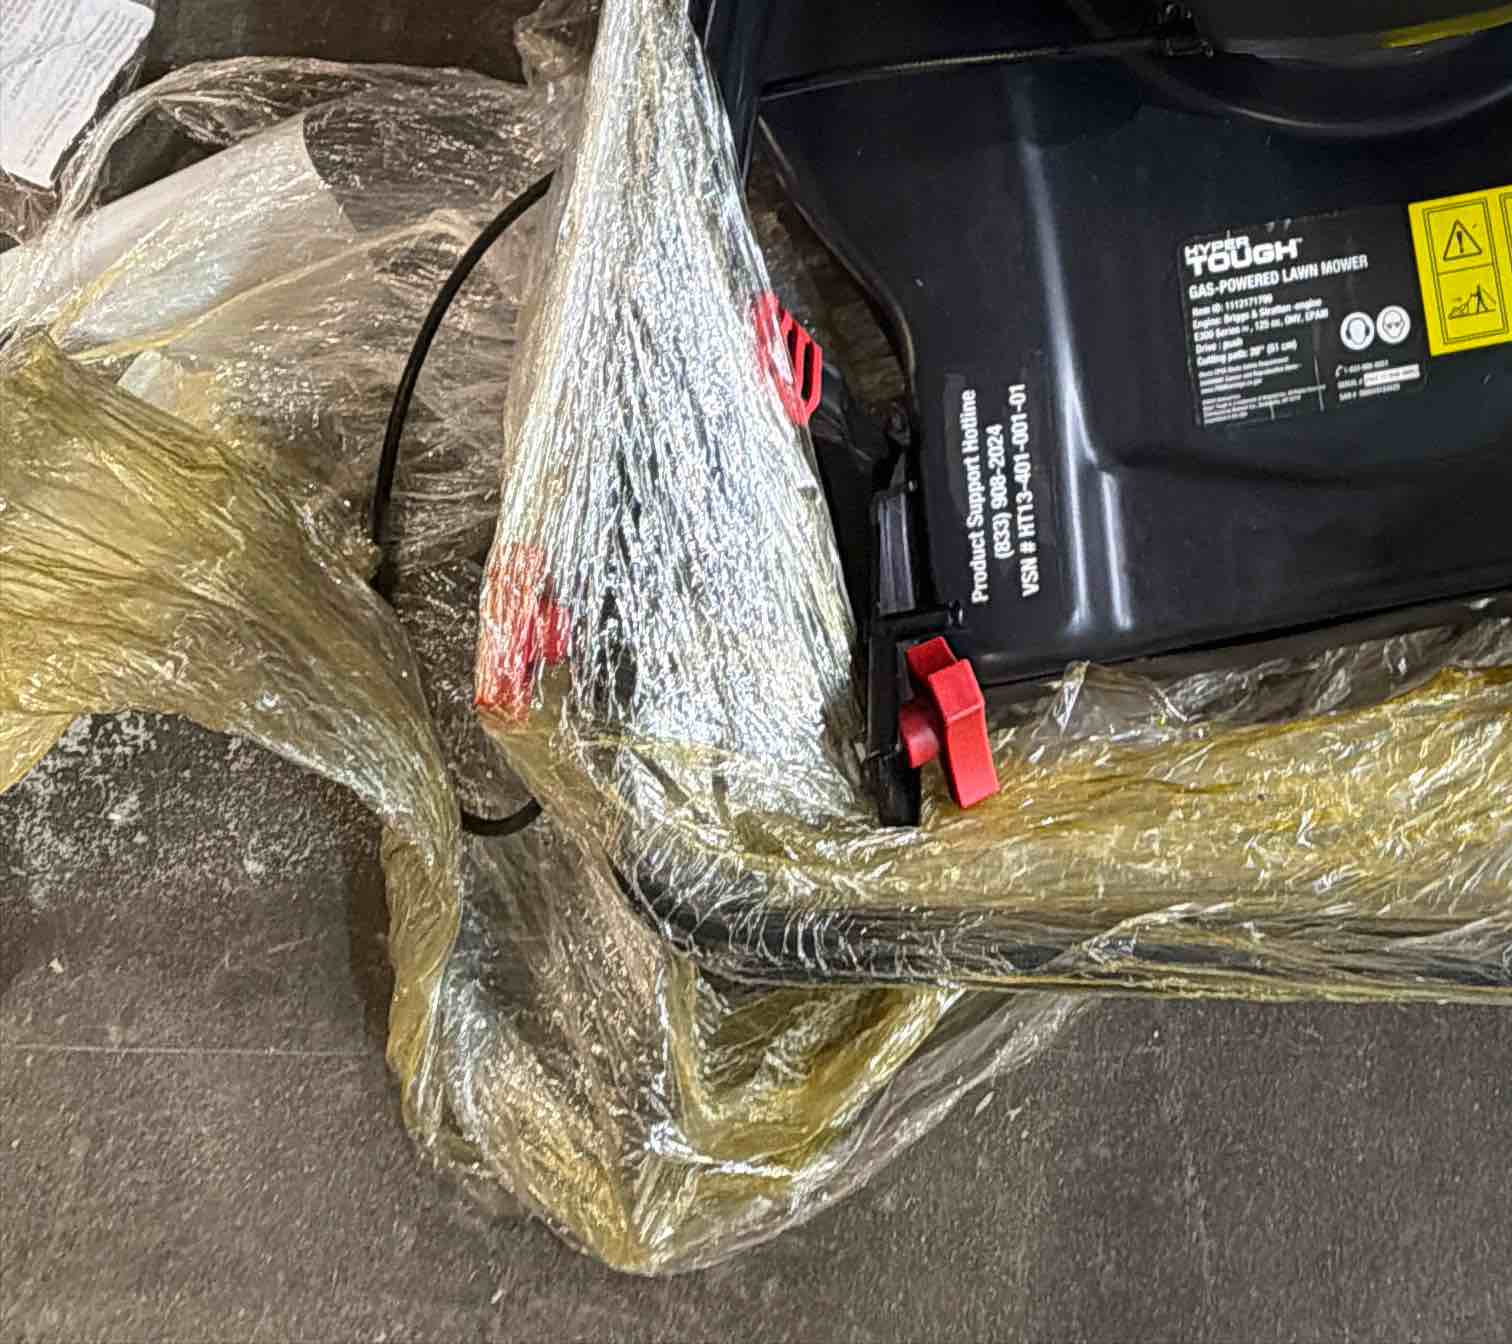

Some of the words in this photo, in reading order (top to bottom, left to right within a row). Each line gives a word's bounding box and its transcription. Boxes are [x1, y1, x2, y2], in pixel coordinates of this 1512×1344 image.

[1184, 235, 1250, 258] HYPER
[1188, 269, 1280, 300] GAS-POWERED
[1281, 262, 1319, 284] LAWN
[1320, 254, 1369, 277] MOWER
[960, 388, 978, 454] Hotline
[985, 423, 1008, 509] 908-2024
[962, 454, 987, 530] Support
[992, 511, 1015, 561] (833)
[1019, 540, 1037, 555] #
[966, 530, 990, 605] Product
[1019, 557, 1041, 598] VSN
